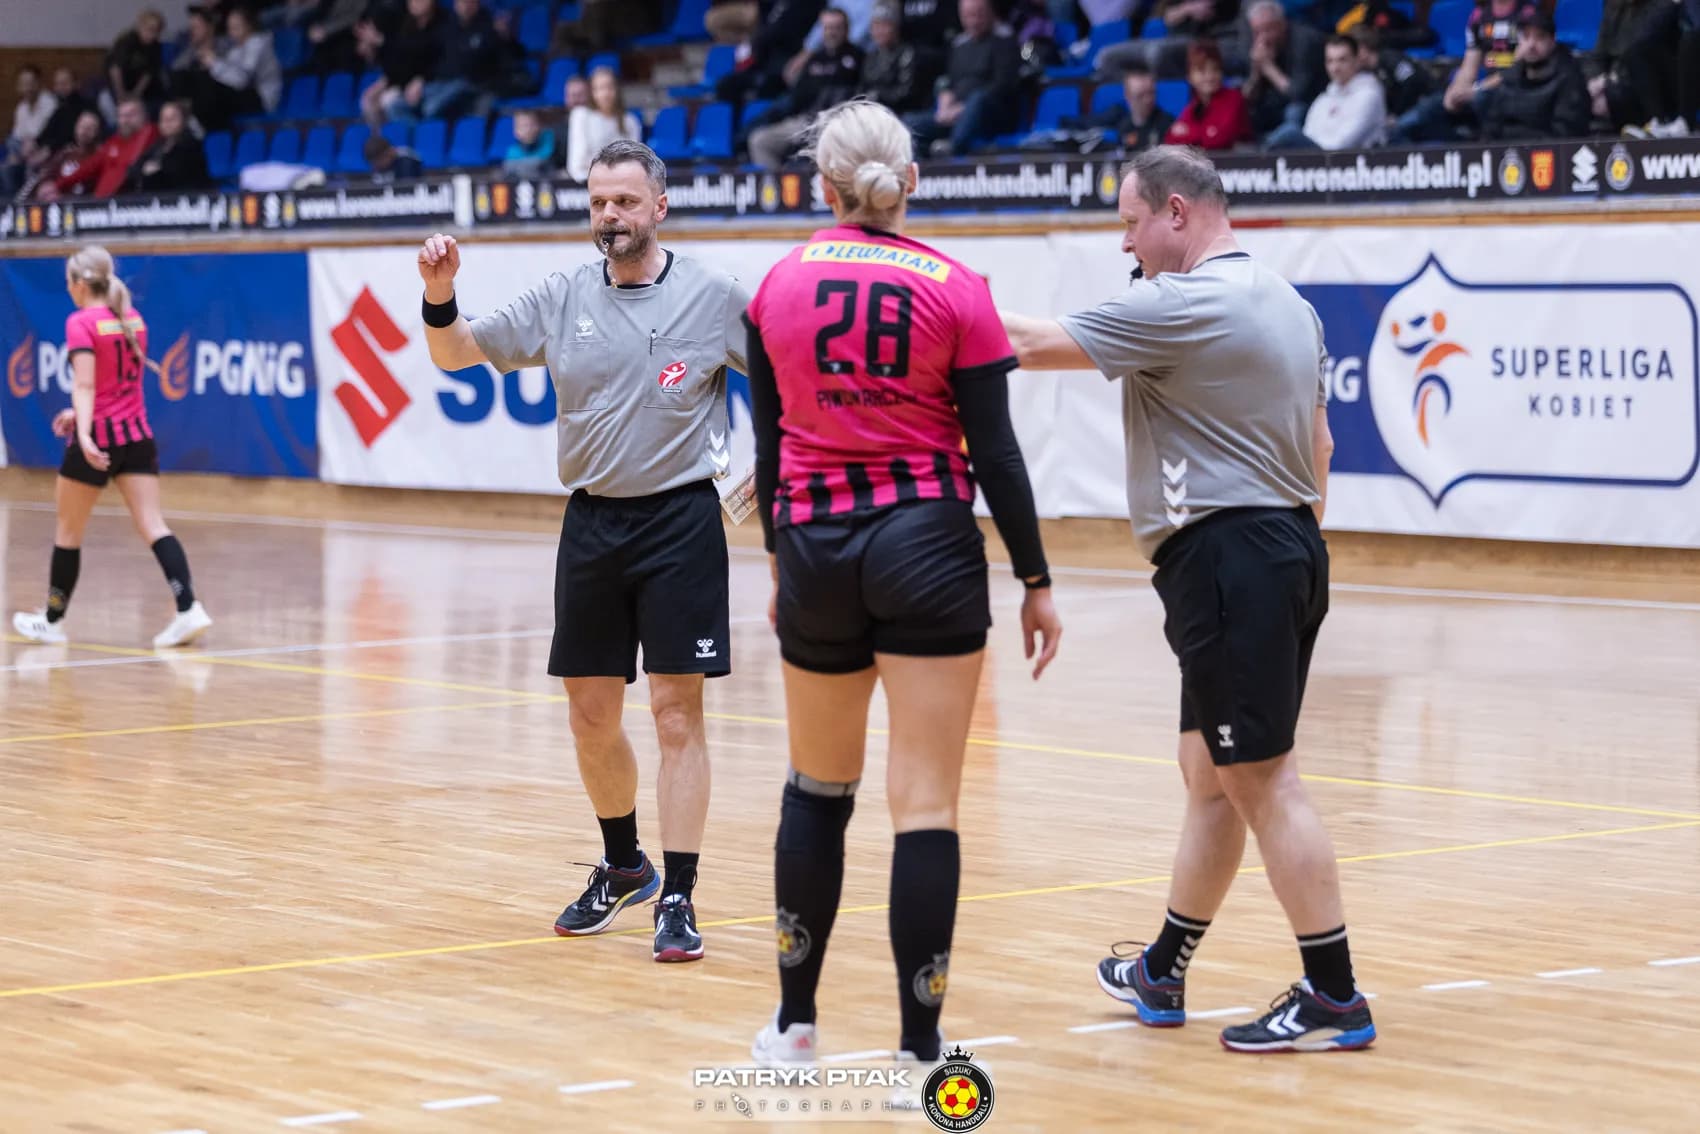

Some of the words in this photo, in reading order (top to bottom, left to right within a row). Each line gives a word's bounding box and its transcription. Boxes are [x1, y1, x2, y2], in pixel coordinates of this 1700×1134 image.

[1218, 150, 1492, 197] www.koronahandball.pl
[815, 279, 912, 378] 28
[194, 338, 307, 398] PGNiG
[1490, 347, 1674, 380] SUPERLIGA
[1529, 395, 1634, 418] KOBIET
